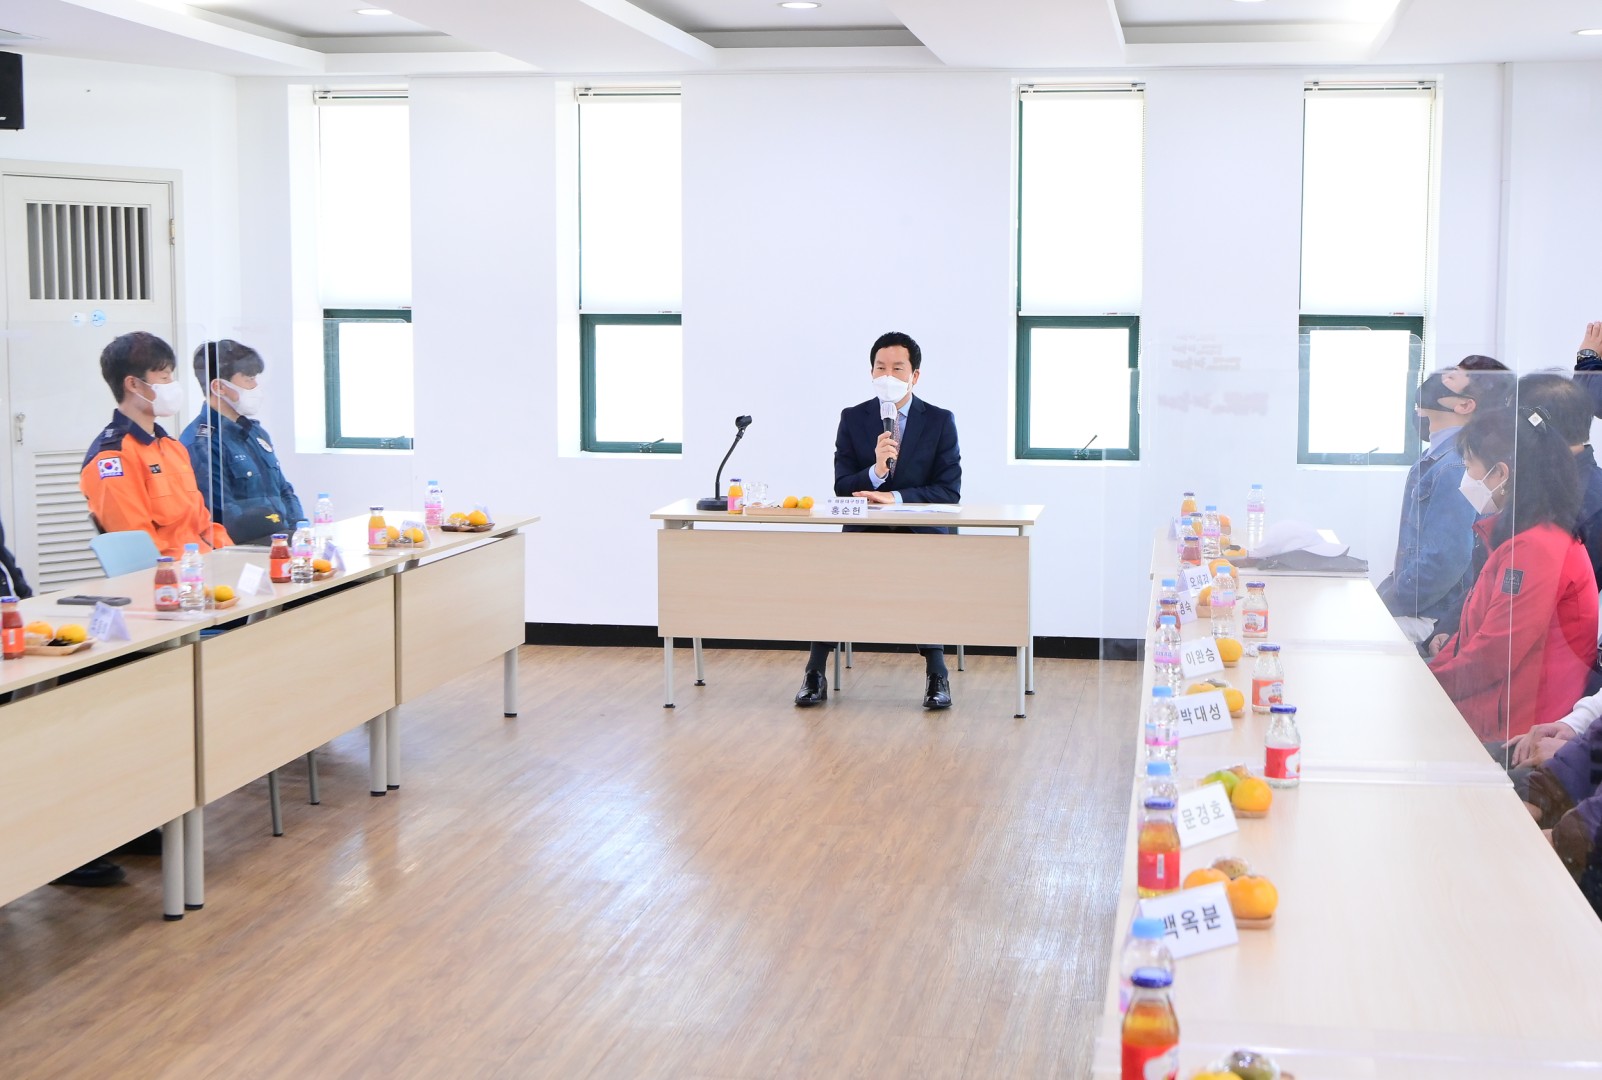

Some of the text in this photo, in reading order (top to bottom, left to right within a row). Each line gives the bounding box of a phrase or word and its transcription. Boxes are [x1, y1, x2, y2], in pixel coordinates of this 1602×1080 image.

[1185, 647, 1215, 666] 이완승
[1180, 703, 1221, 725] 박대성
[1181, 800, 1225, 830] 문경호
